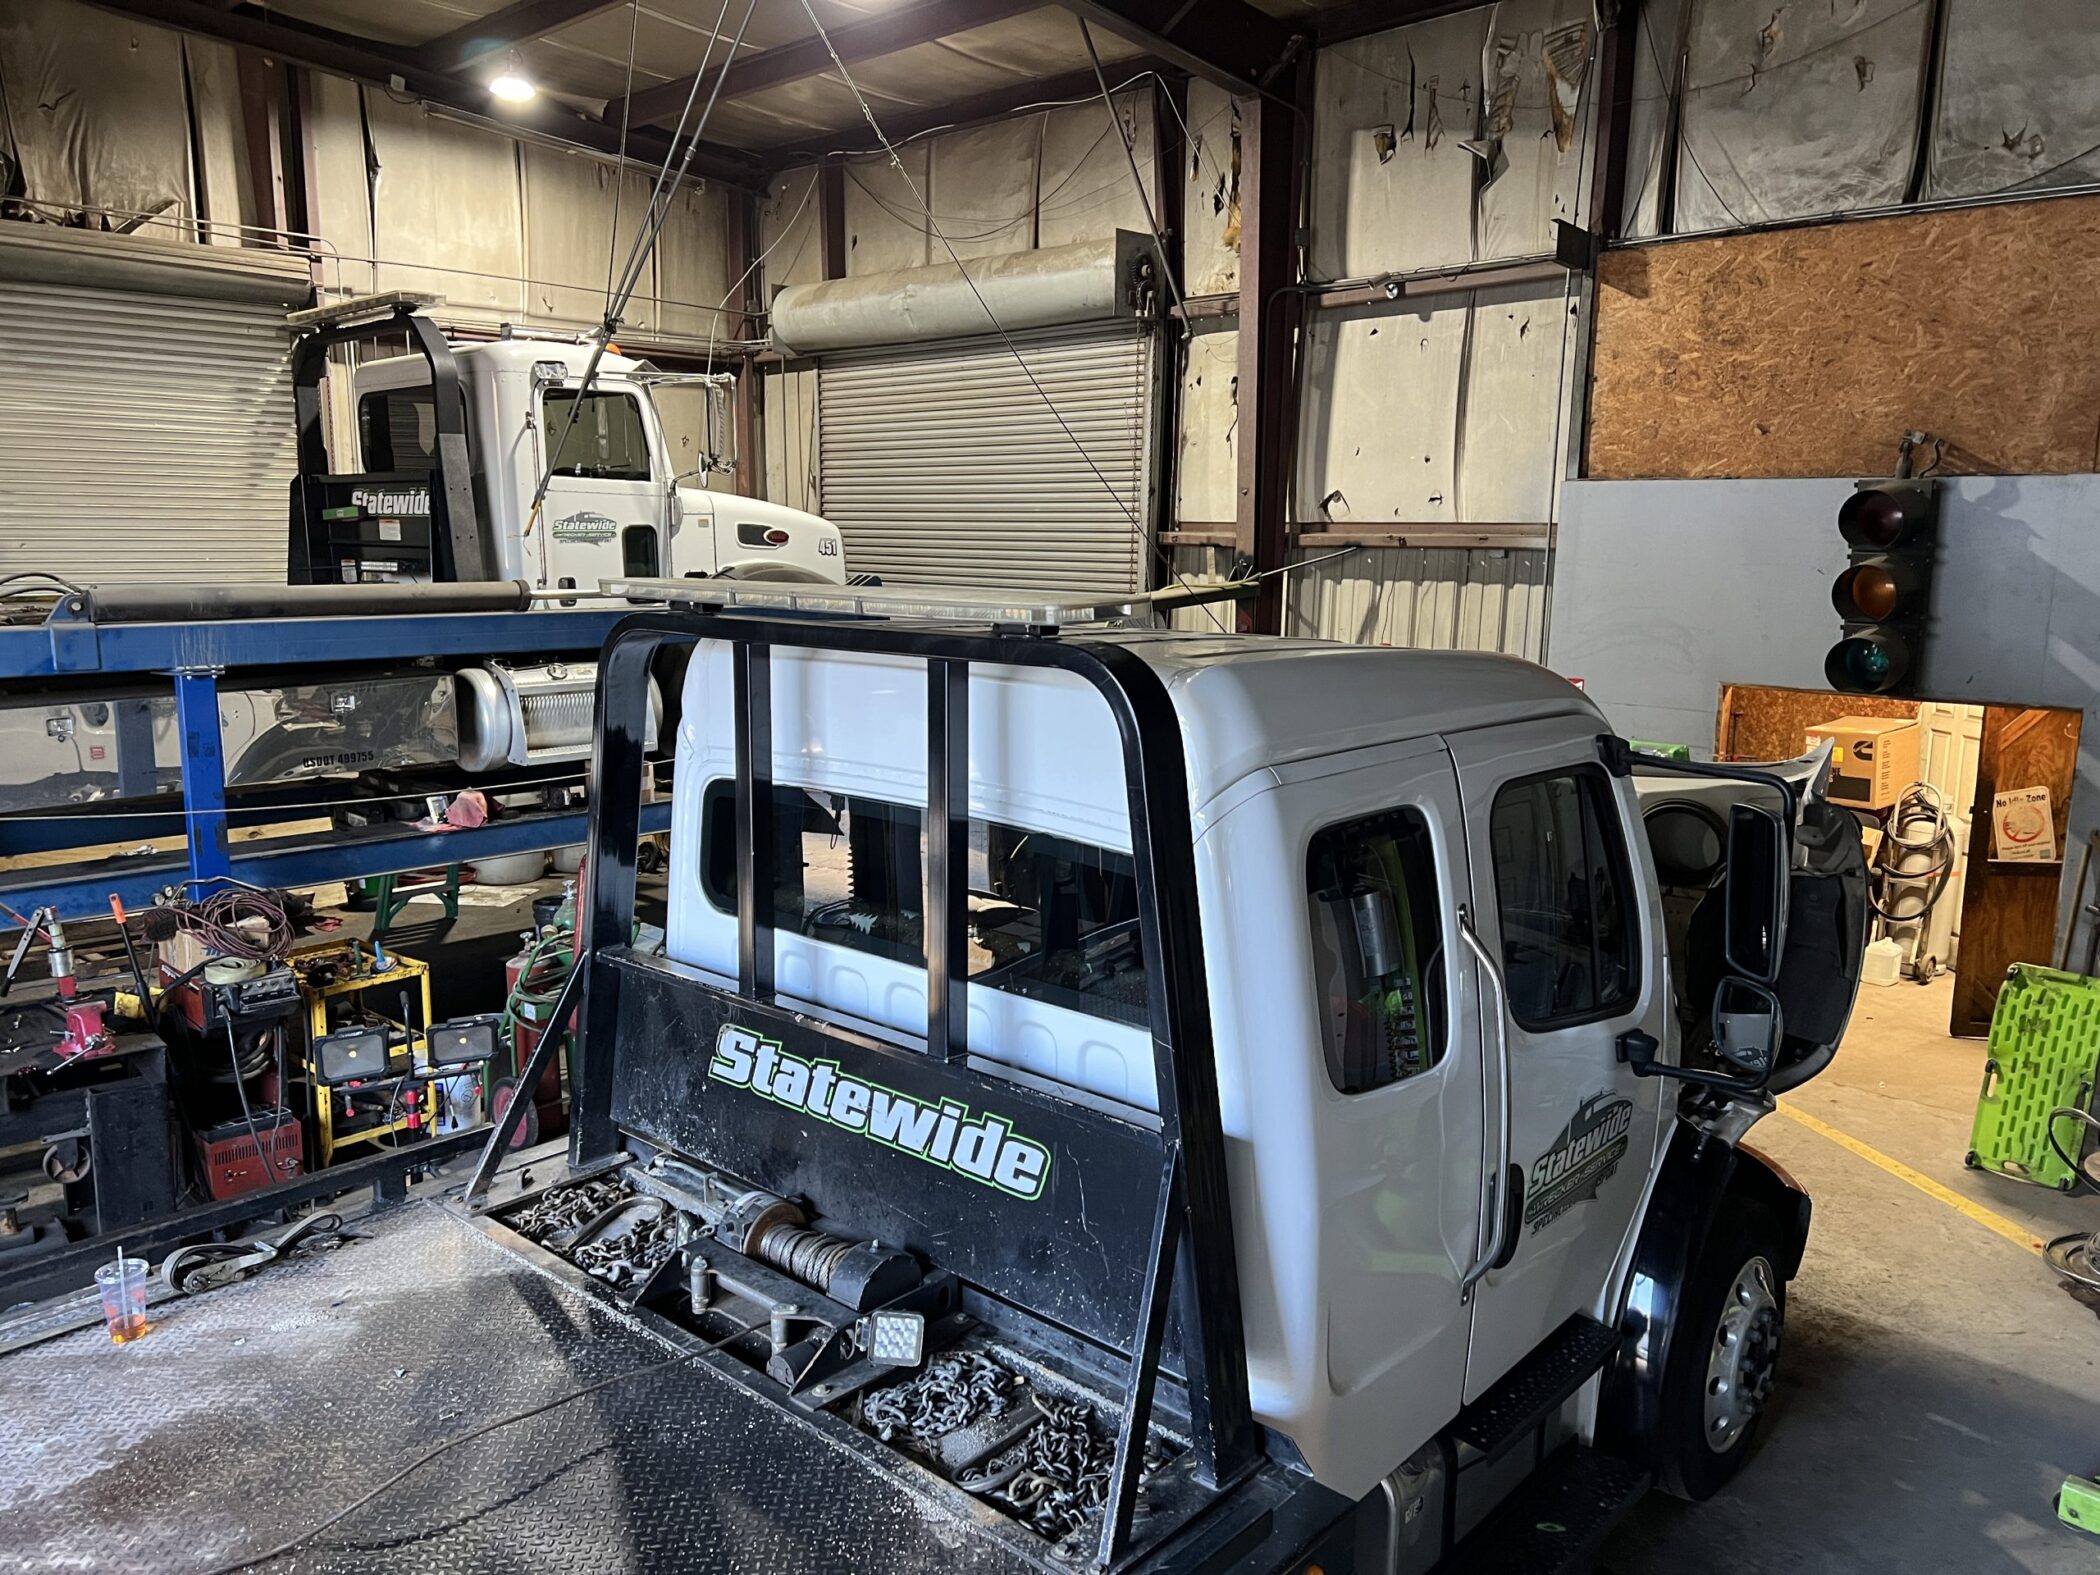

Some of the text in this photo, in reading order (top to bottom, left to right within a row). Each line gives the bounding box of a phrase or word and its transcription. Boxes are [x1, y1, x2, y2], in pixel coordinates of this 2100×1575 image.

[352, 489, 430, 515] Statewide
[553, 519, 617, 531] Statewide
[818, 537, 838, 556] 451
[303, 751, 374, 767] USDOT 499755
[1995, 799, 2007, 809] No
[2025, 793, 2047, 803] Zone
[709, 1025, 1049, 1199] Statewide
[1528, 1101, 1633, 1197] Statewide
[1584, 1142, 1623, 1177] SERVICE
